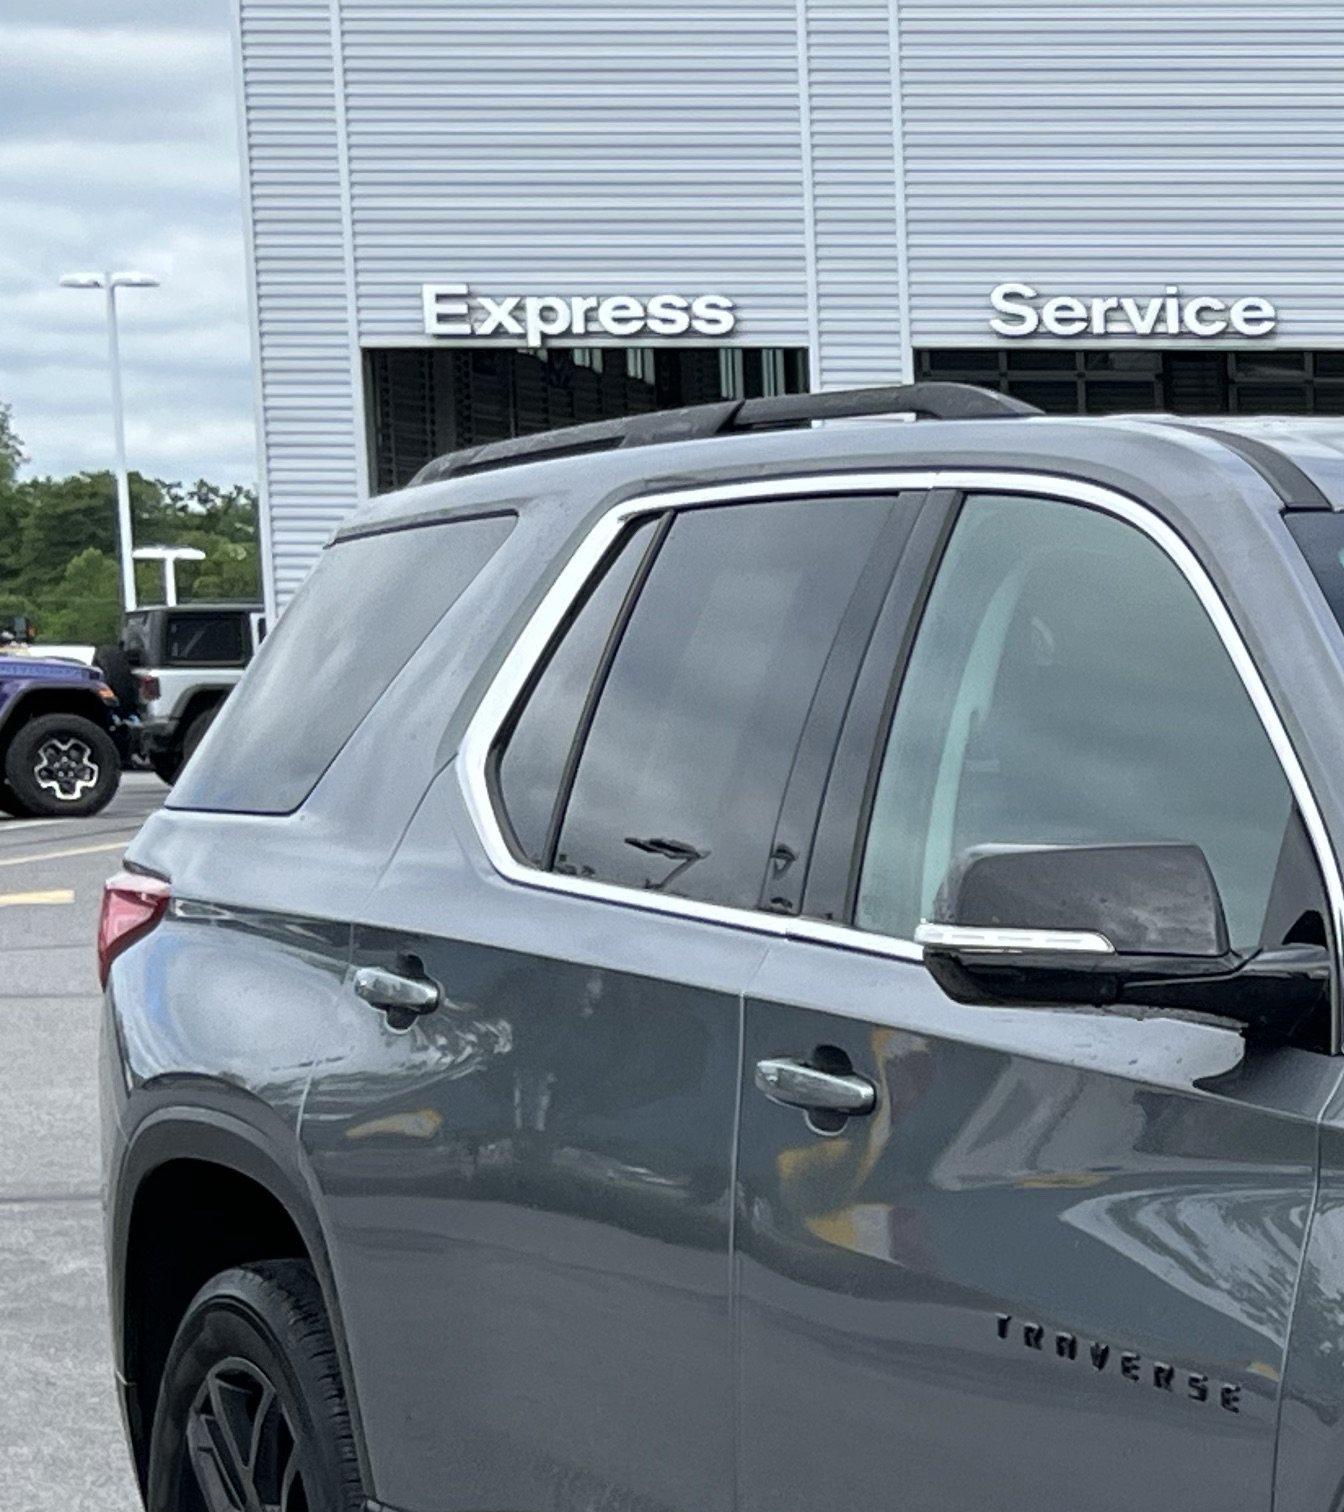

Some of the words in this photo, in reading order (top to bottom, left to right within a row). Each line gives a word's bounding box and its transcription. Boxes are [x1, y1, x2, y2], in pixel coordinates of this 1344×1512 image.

[421, 283, 738, 348] Express
[989, 281, 1278, 338] Service
[995, 1312, 1243, 1413] TRAVERSE
